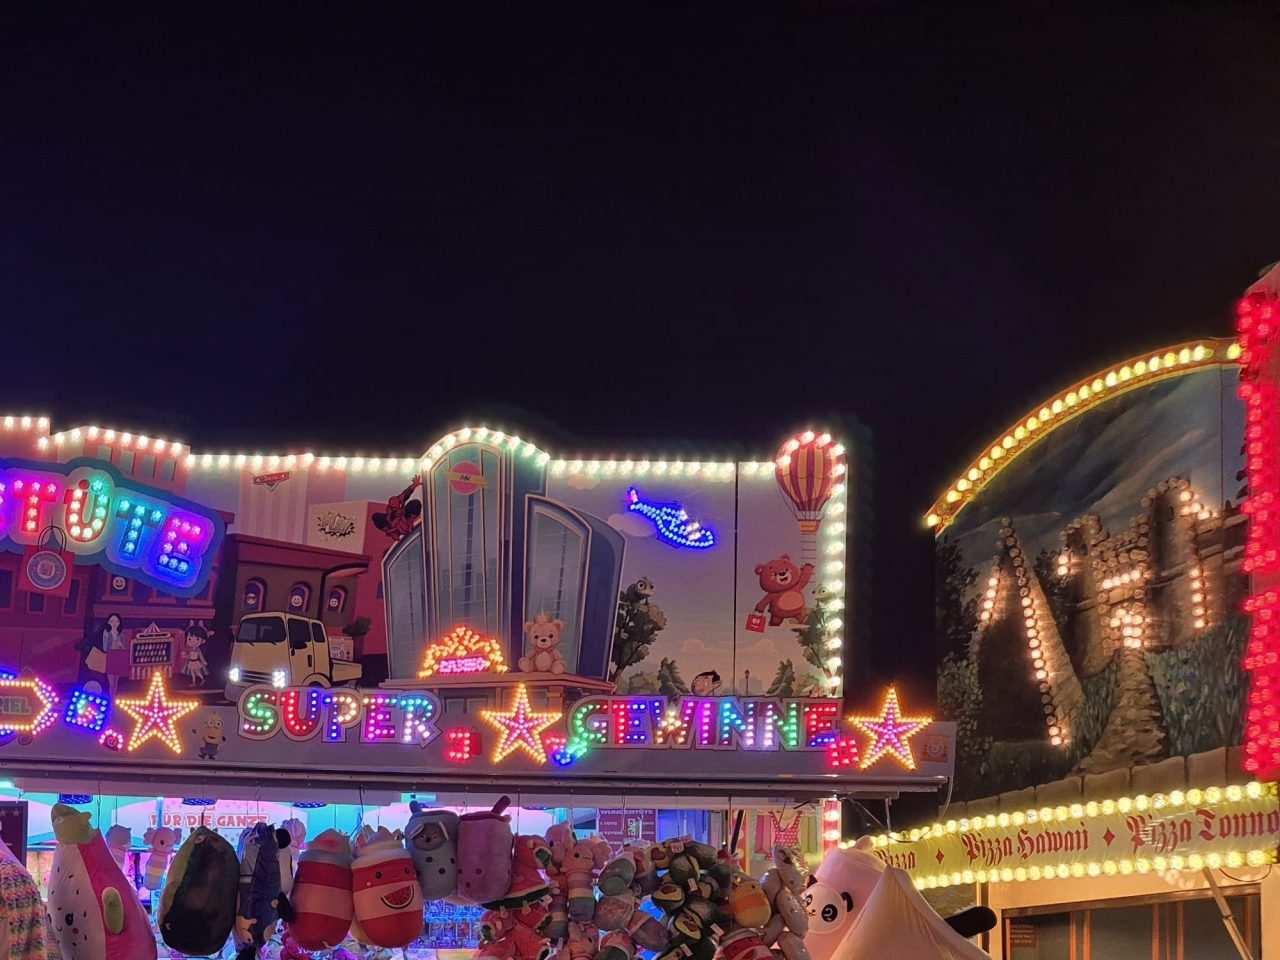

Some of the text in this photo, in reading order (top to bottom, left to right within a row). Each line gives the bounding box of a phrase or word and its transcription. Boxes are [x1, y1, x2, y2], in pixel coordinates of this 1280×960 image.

[241, 690, 840, 748] SUPER GEWINNE
[961, 829, 1013, 867] Pizza
[1017, 821, 1089, 860] Hawaii
[1126, 814, 1192, 855] Pizza
[1195, 807, 1280, 841] Tonno
